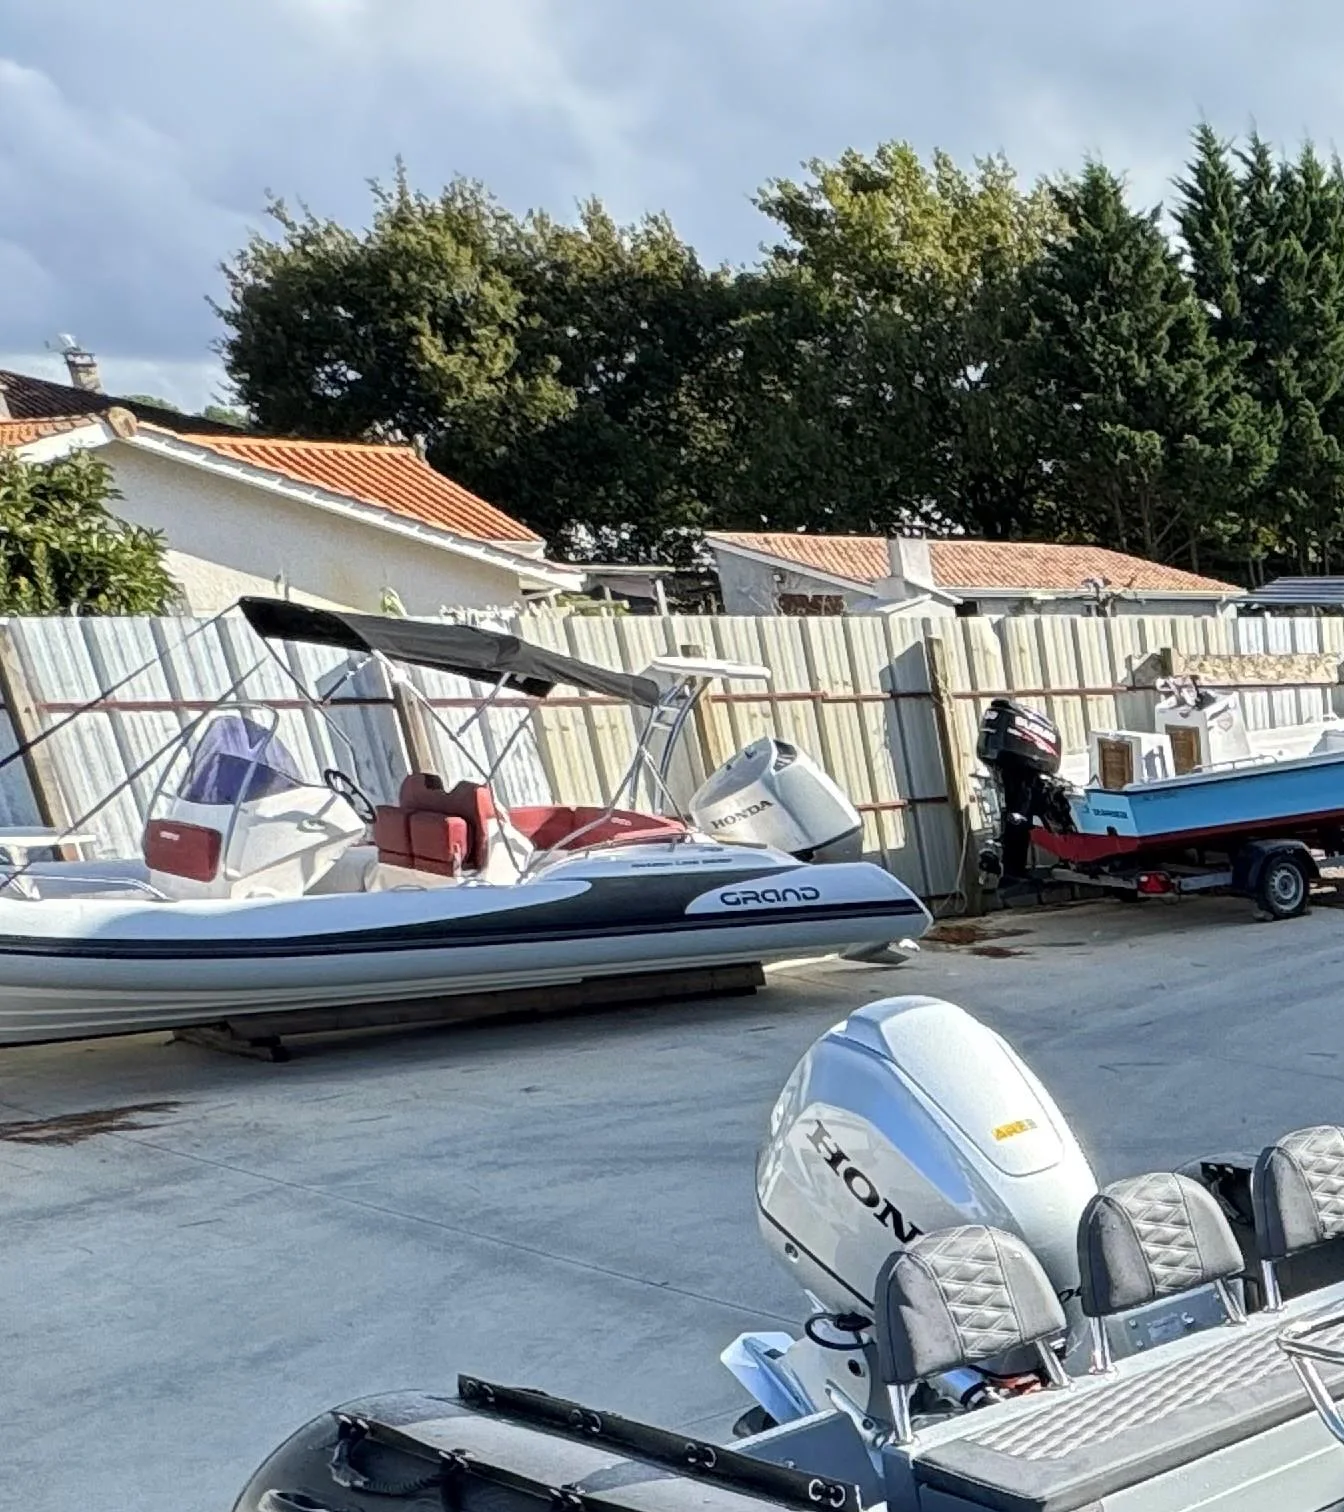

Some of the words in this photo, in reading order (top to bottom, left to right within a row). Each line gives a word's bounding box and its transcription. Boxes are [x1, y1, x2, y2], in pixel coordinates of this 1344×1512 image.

[710, 800, 773, 829] HONDA
[720, 887, 820, 906] GRAND
[805, 1119, 925, 1245] HON
